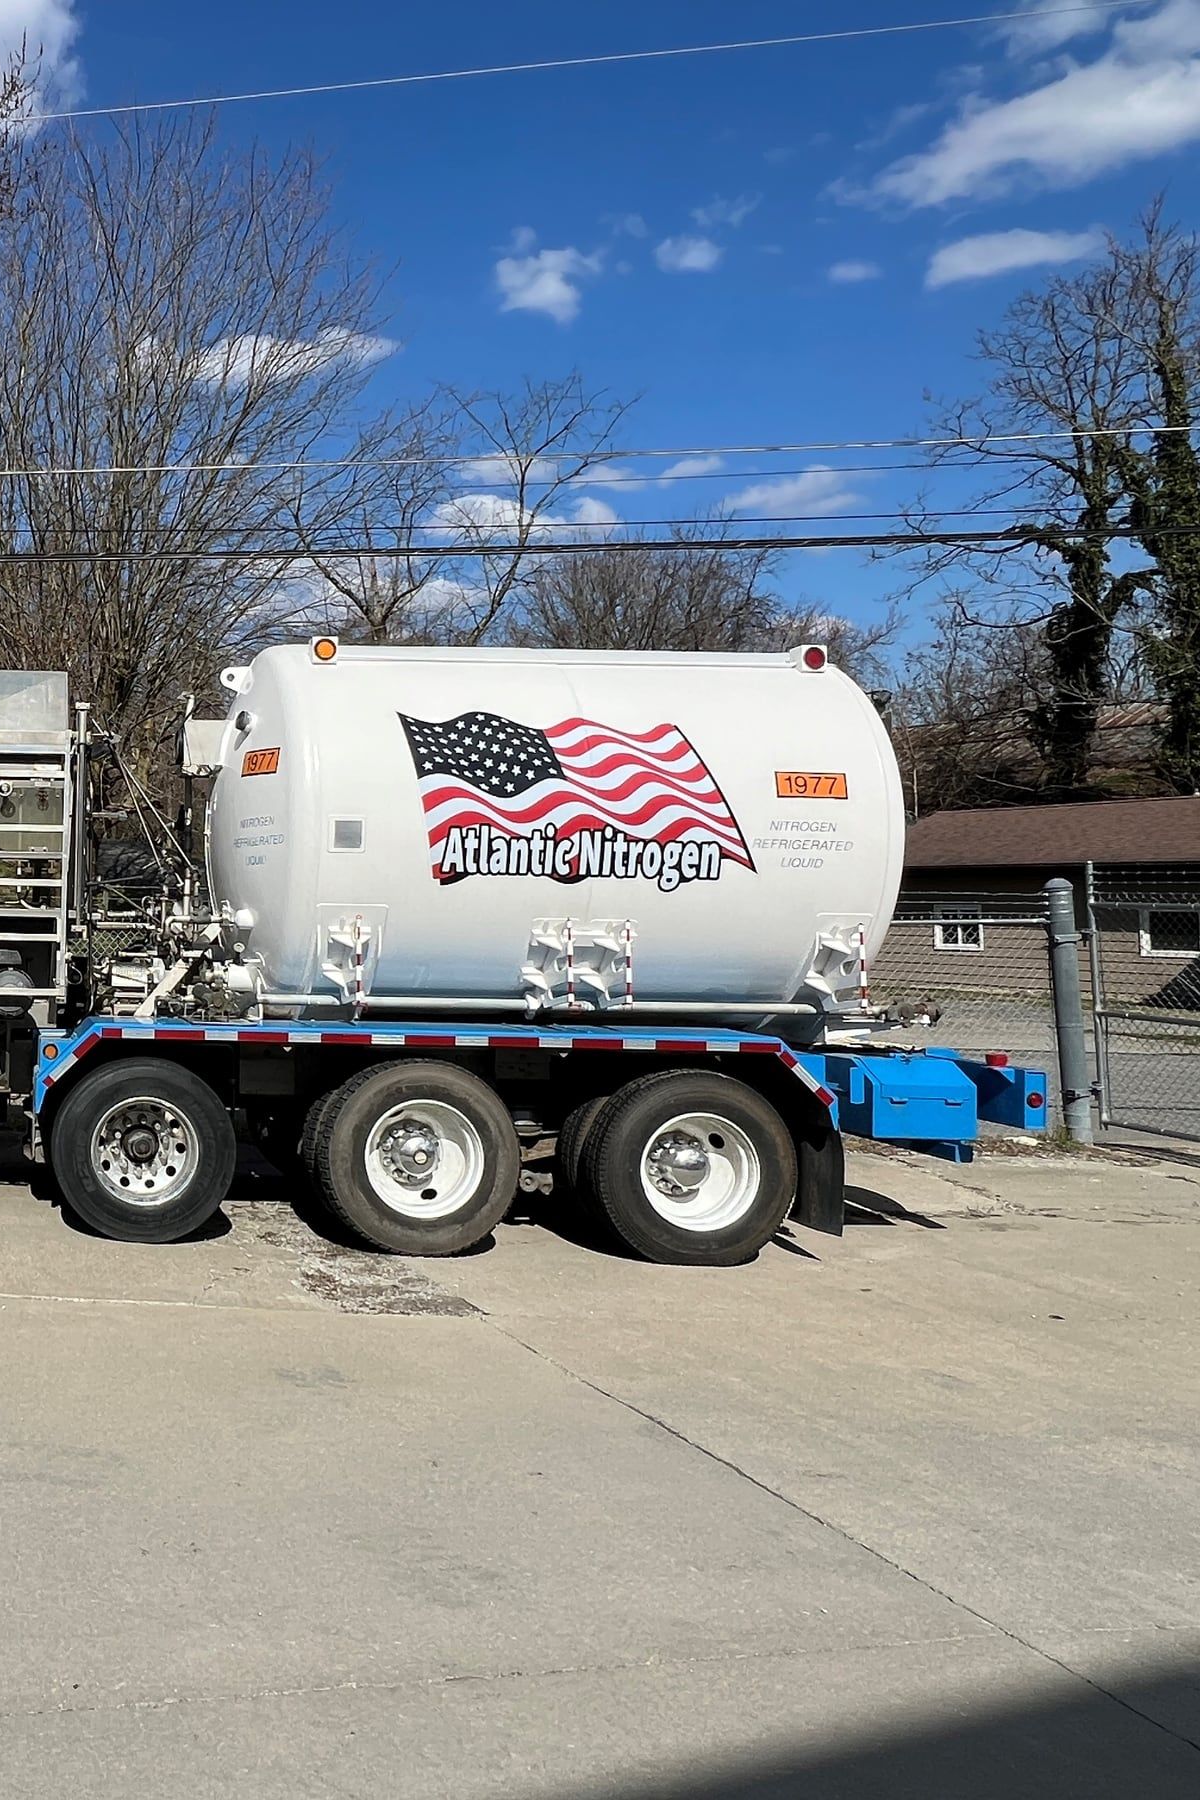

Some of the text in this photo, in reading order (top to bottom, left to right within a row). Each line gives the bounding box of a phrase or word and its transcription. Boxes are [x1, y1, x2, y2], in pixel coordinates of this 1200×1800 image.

[246, 751, 276, 773] 1977
[784, 775, 838, 795] 1977
[240, 815, 275, 829] NITROGEN
[769, 820, 838, 833] NITROGEN
[752, 838, 854, 852] REFRIGERATED
[439, 822, 724, 892] Atlantic Nitrogen
[780, 857, 824, 869] LIQUID
